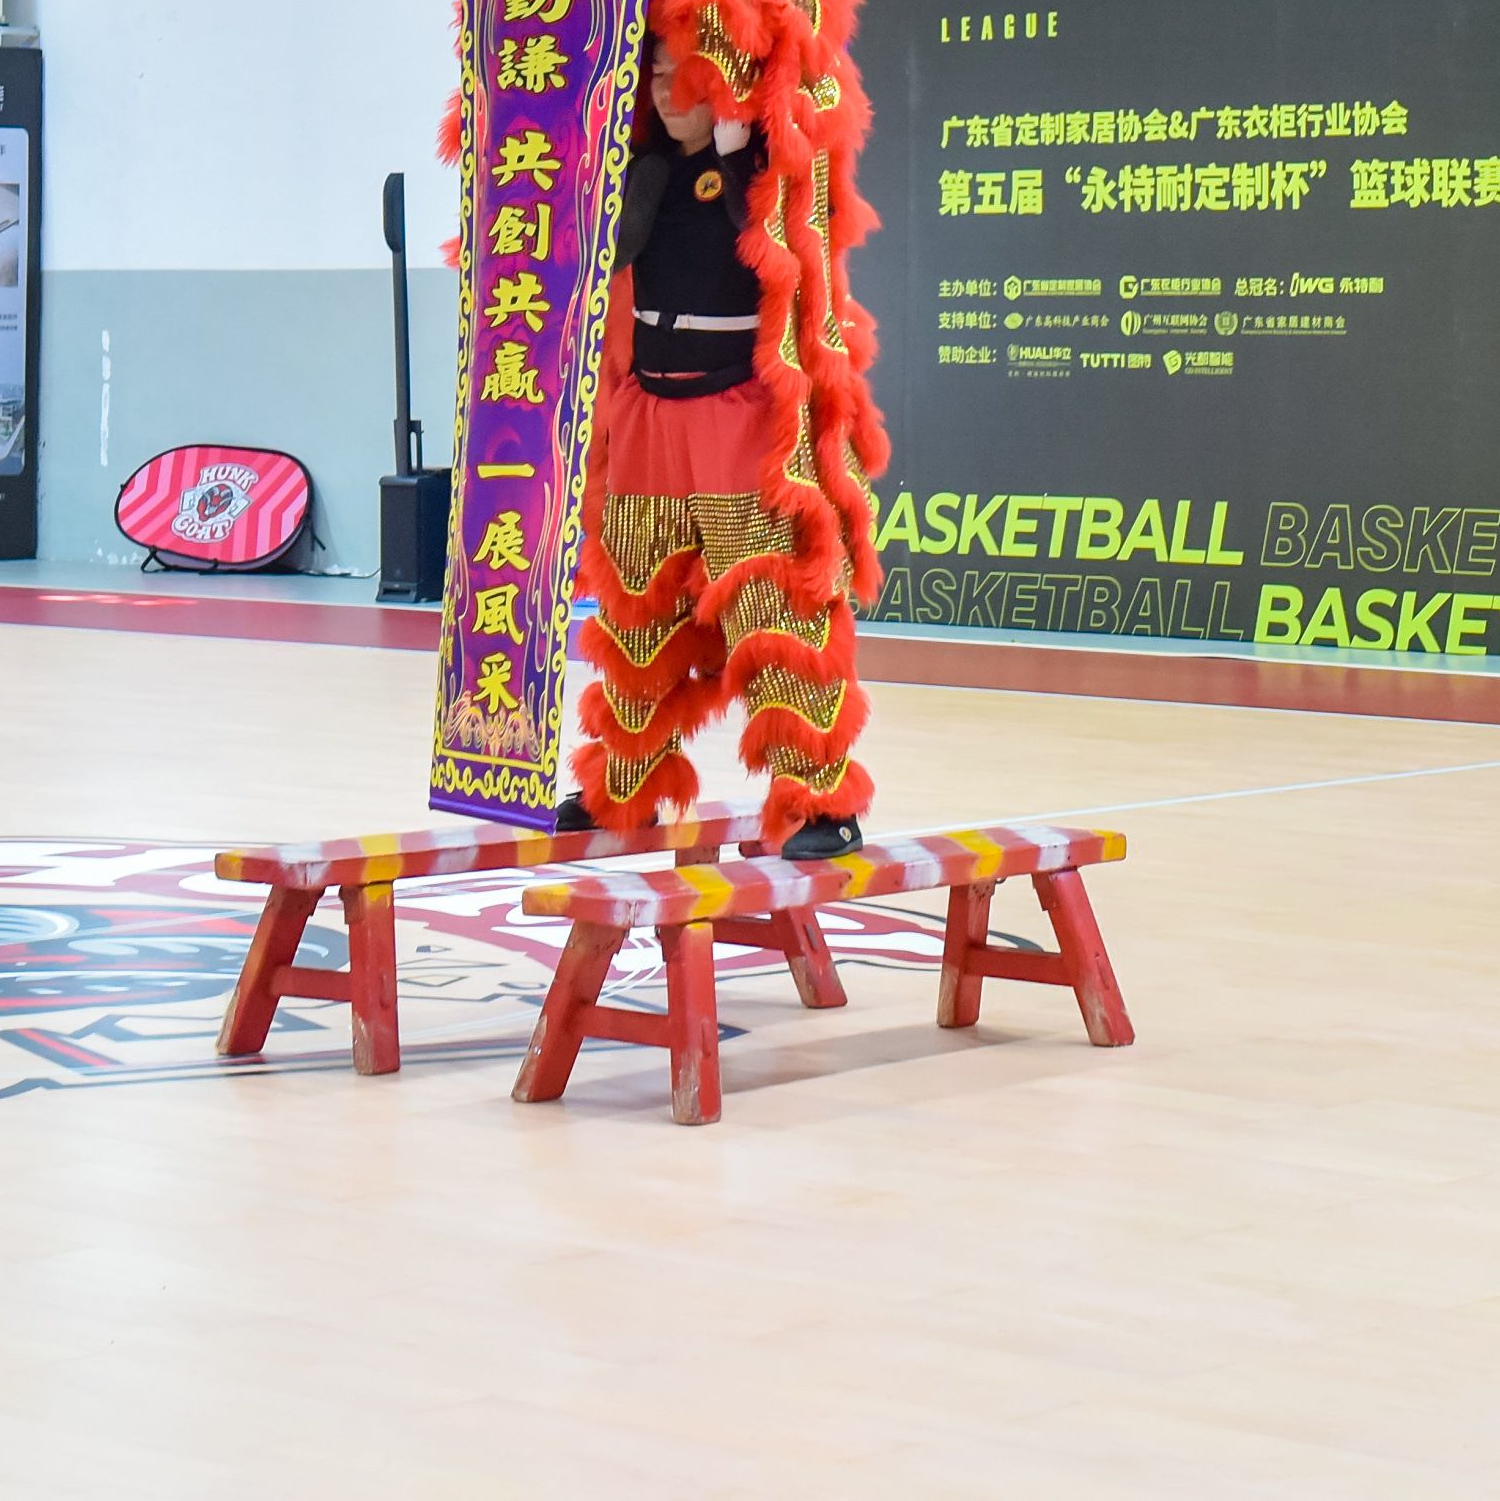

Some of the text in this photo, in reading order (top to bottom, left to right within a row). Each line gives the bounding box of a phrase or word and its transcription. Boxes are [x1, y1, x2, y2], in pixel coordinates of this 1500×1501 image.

[941, 12, 1058, 43] LEAGUE
[940, 101, 1408, 148] 广东省定制家居协会&广东衣柜行业协会
[481, 129, 562, 404] 共創共贏
[201, 465, 258, 489] HUNK
[173, 515, 232, 540] GOAT
[871, 492, 1244, 565] ASKETBALL
[472, 462, 535, 714] 一展風采
[855, 567, 1244, 641] ASKETBALL
